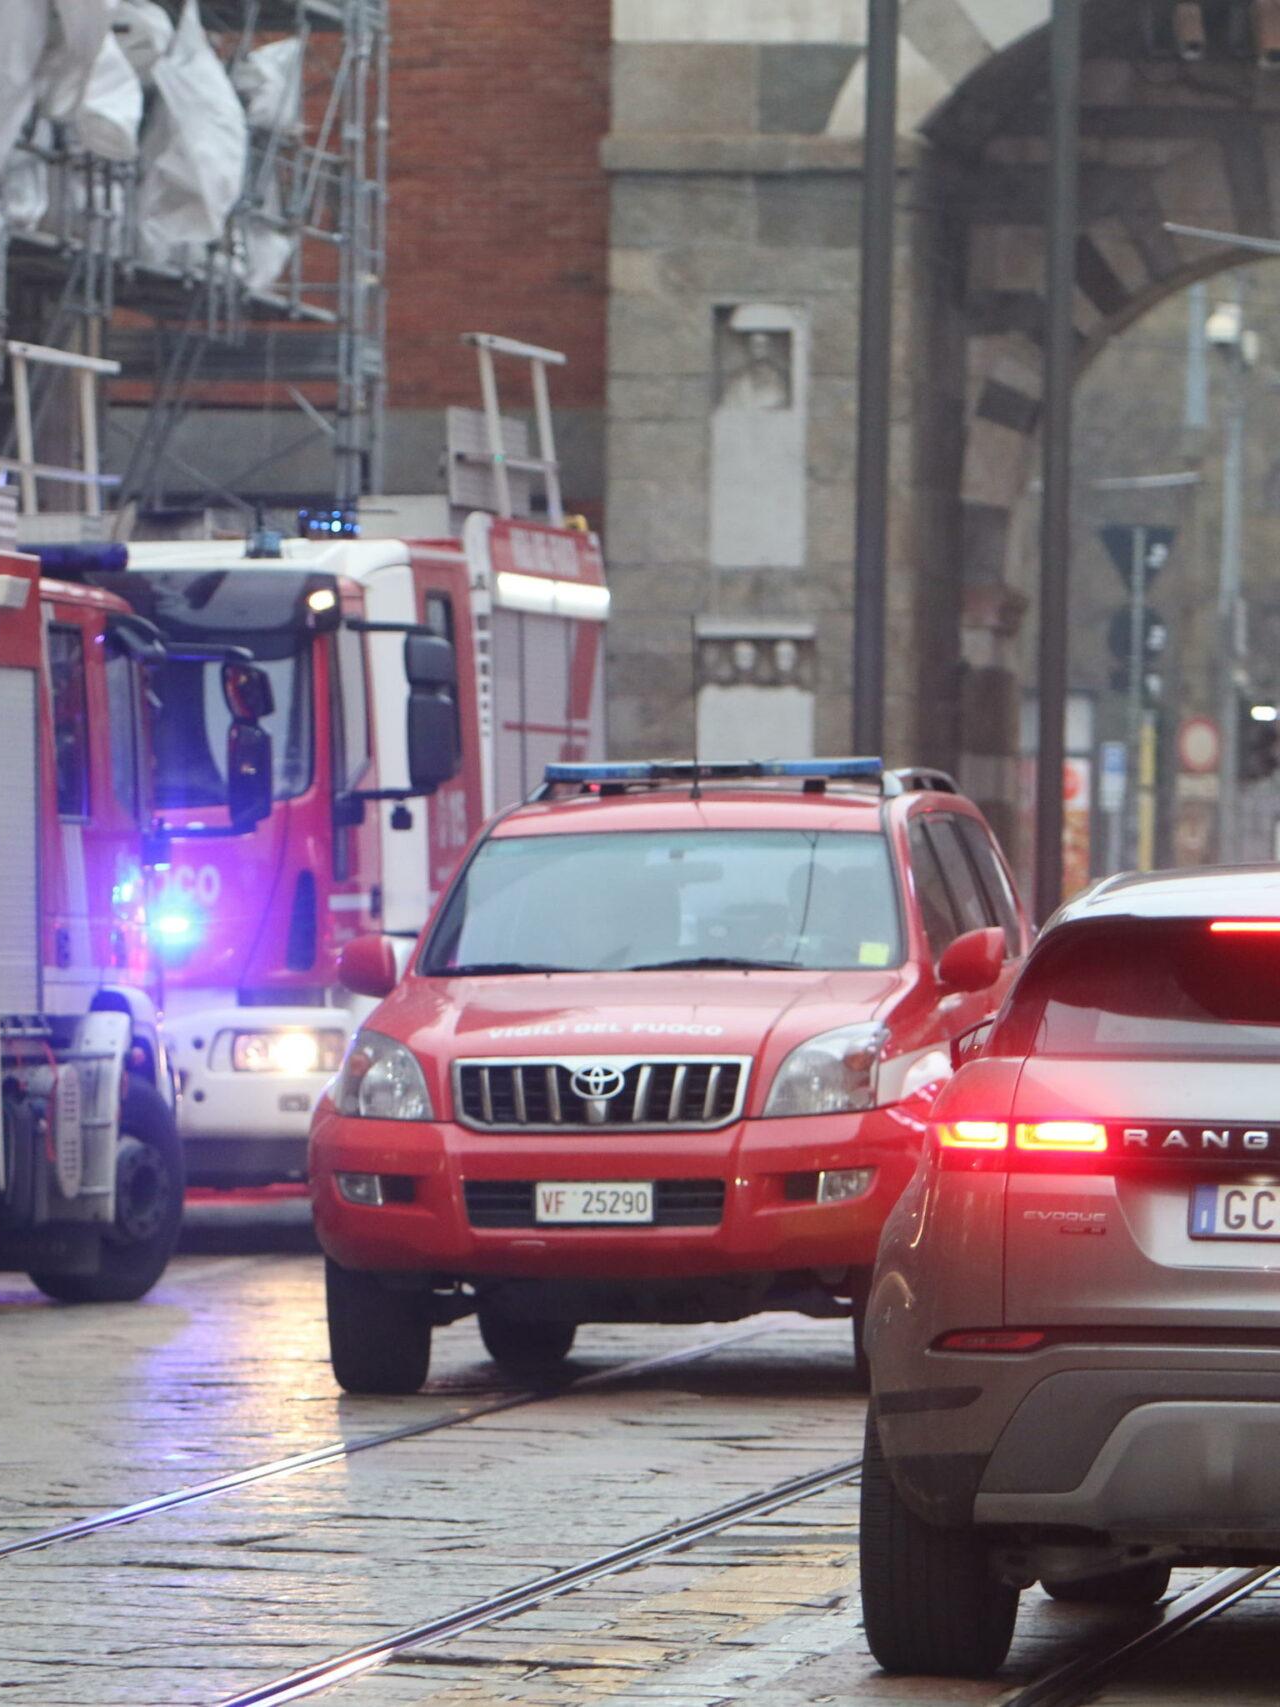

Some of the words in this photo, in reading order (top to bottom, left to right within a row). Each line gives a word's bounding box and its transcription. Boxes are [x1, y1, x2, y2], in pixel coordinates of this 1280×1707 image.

[489, 1024, 565, 1039] VIGILI
[573, 1022, 622, 1034] DEL
[630, 1023, 724, 1036] FUOCO
[1122, 1127, 1270, 1150] RANG
[541, 1190, 566, 1215] VF
[581, 1190, 648, 1215] 25290
[1023, 1210, 1107, 1222] EVOQUE
